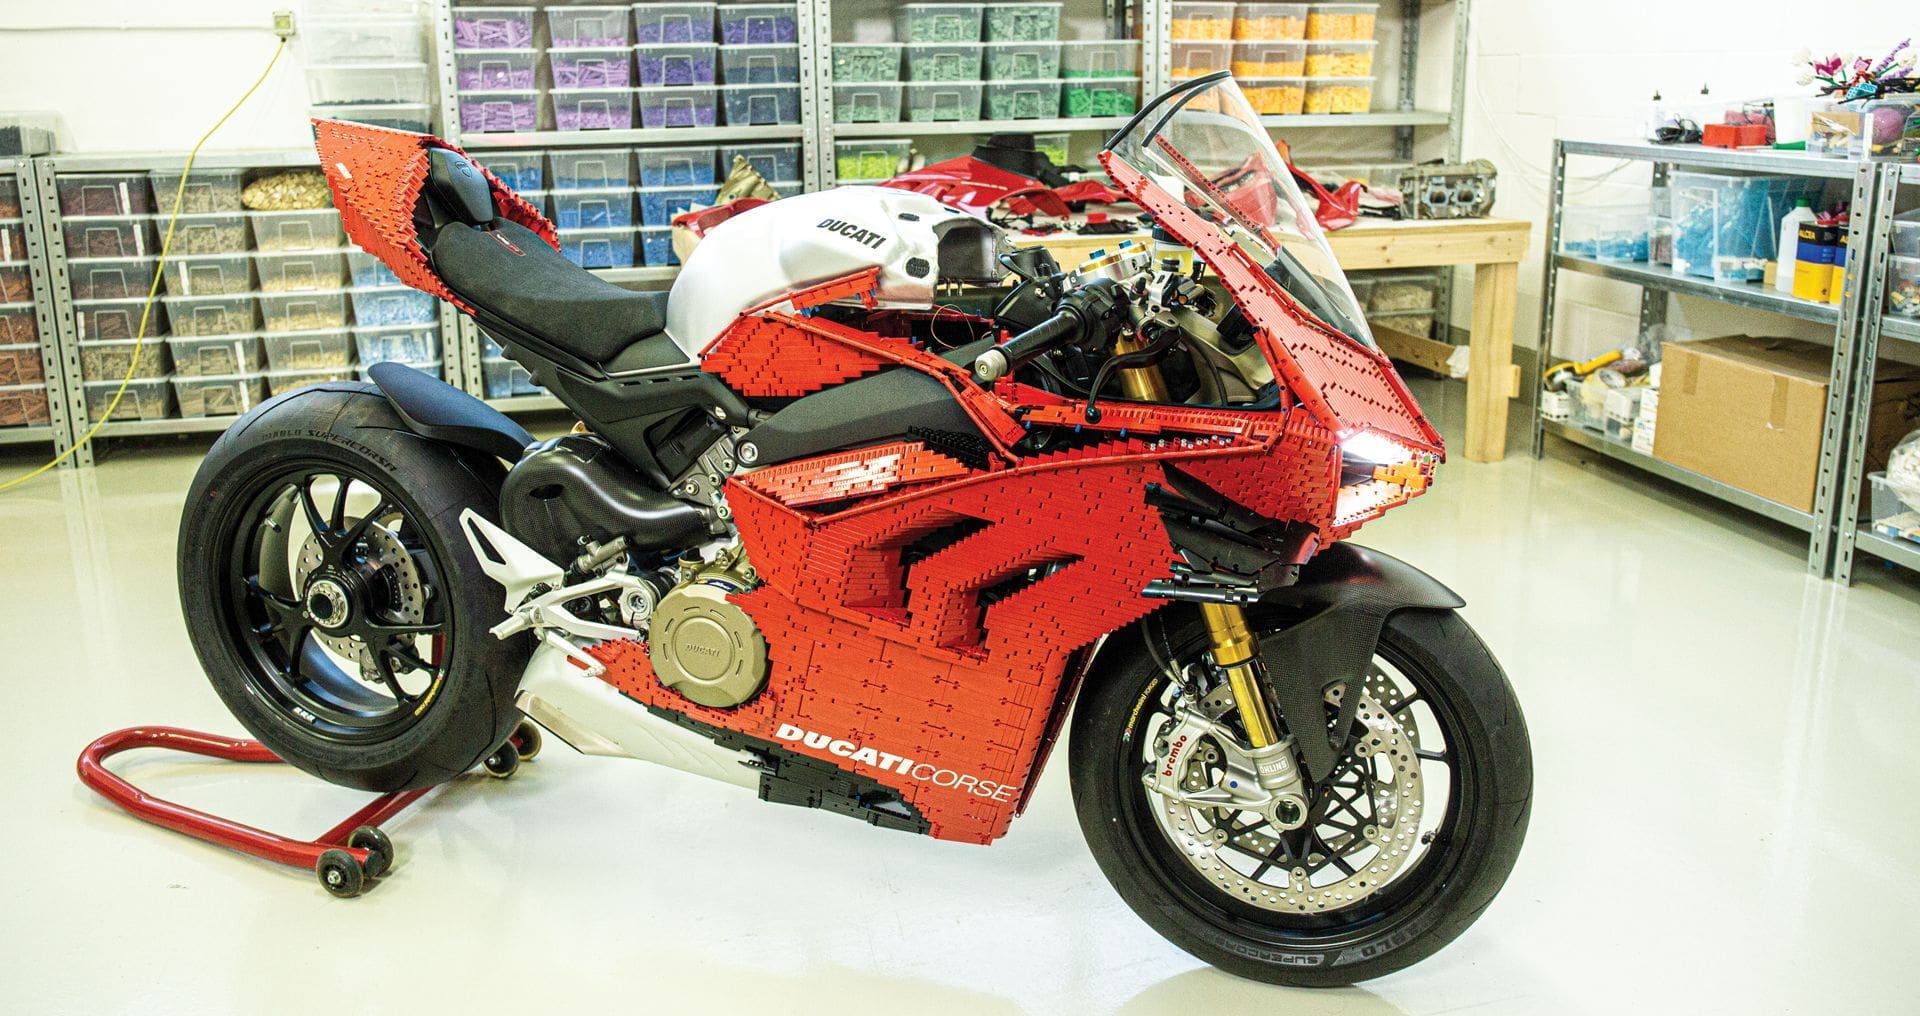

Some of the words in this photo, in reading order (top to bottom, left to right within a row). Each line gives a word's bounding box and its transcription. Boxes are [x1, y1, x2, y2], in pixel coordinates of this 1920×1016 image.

[816, 218, 887, 250] DUCATI
[307, 429, 398, 472] SUPERCORSA
[686, 643, 721, 657] DUCATI
[1162, 735, 1188, 777] brembo
[1205, 929, 1319, 965] SUPERCORS
